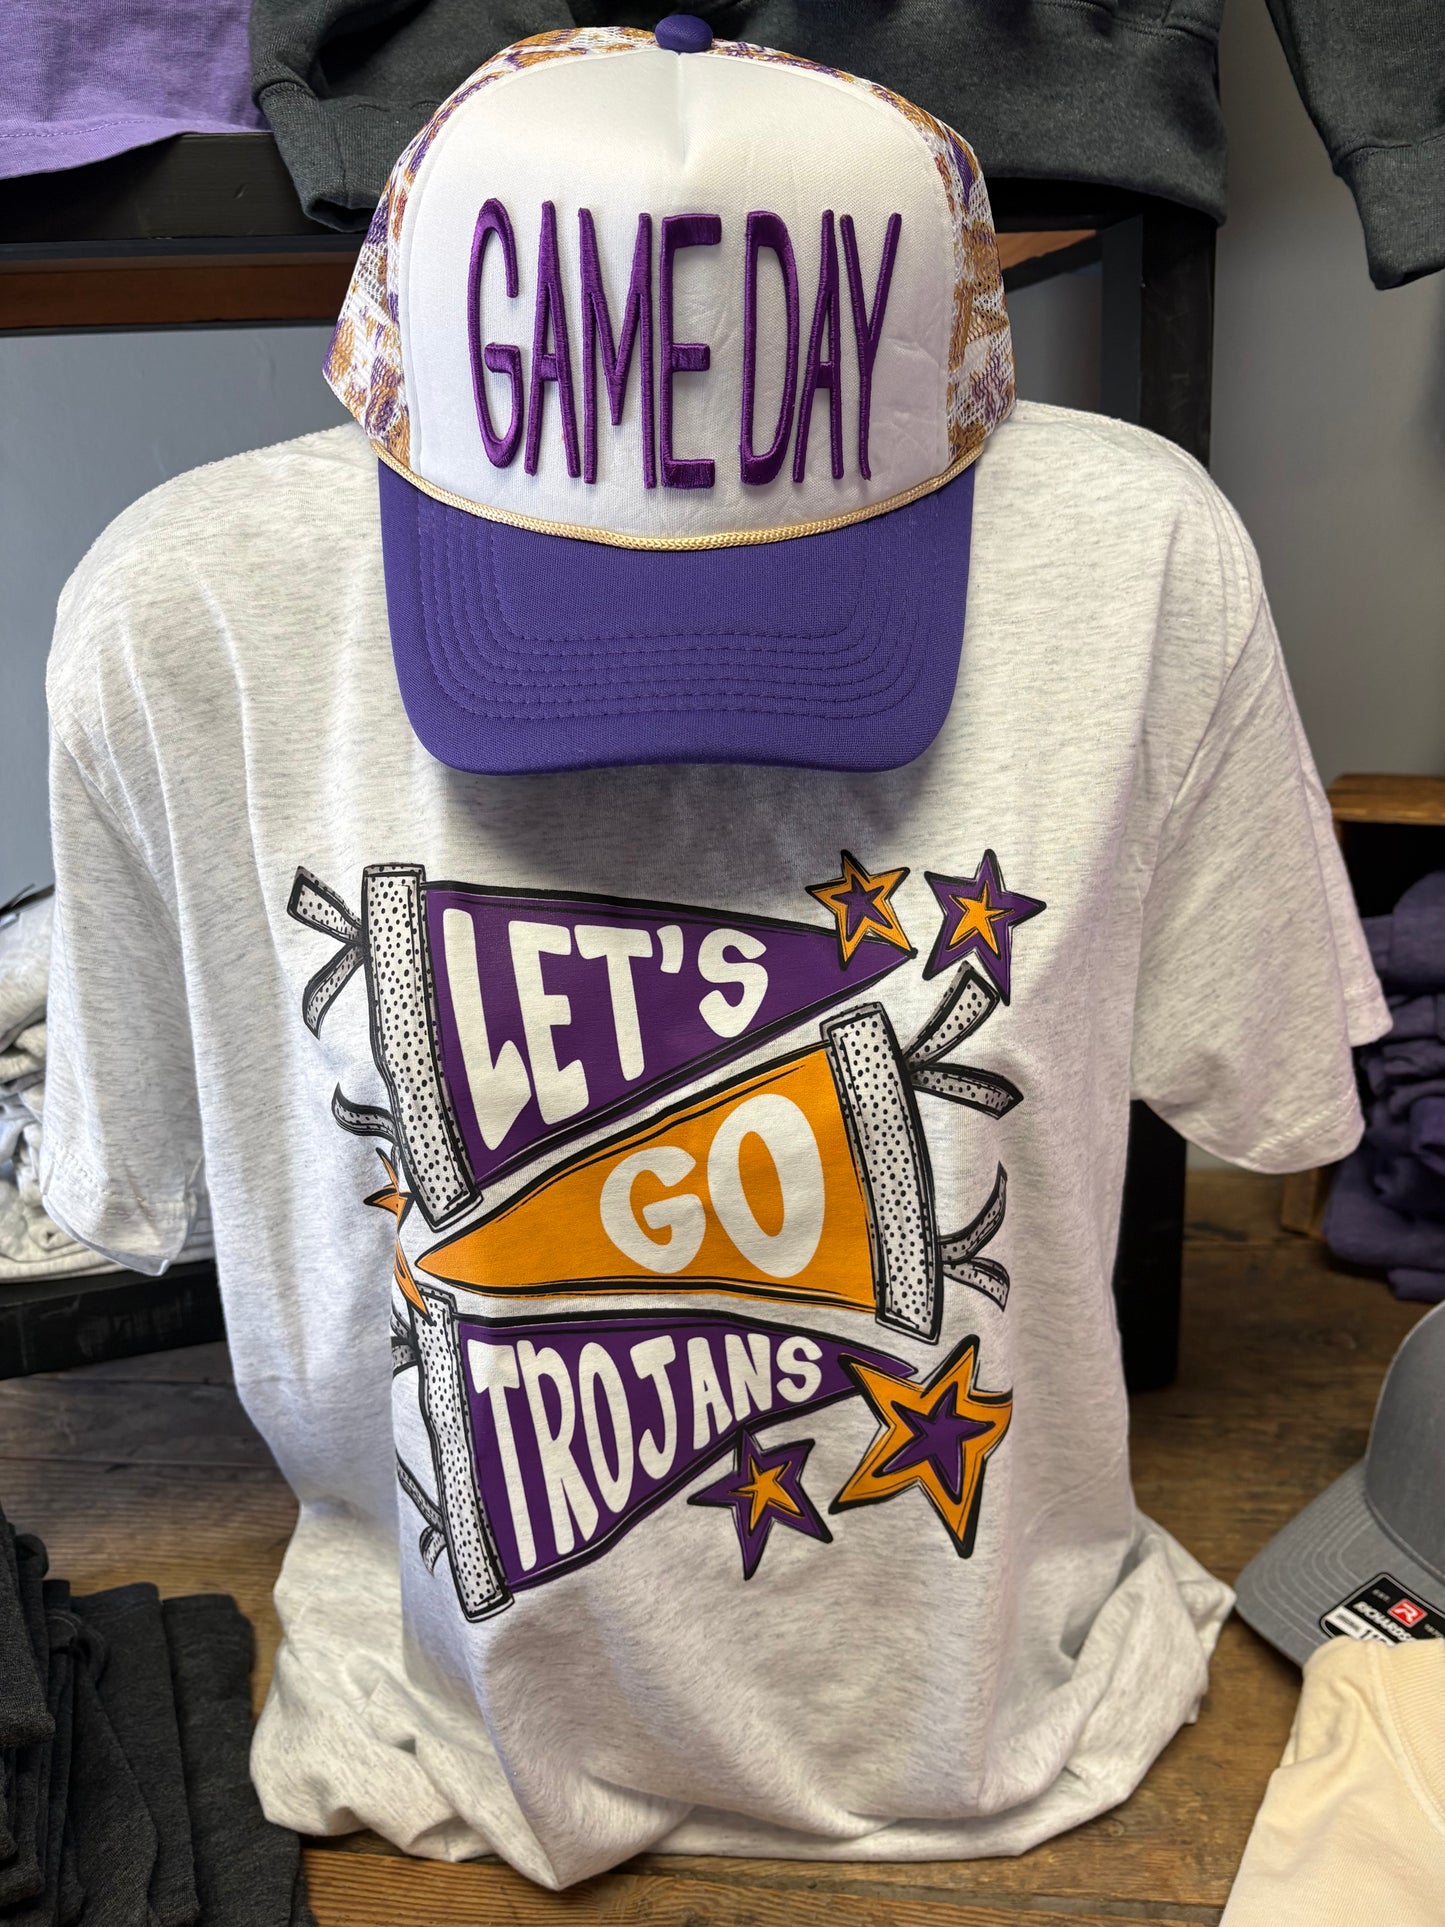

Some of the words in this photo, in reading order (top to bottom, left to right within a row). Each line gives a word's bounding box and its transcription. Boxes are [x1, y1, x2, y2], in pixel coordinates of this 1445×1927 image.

[467, 198, 721, 489] GAME
[739, 210, 902, 486] DAY
[443, 909, 769, 1150] LET'S
[599, 1093, 825, 1278] GO
[467, 1334, 823, 1571] TROJANS
